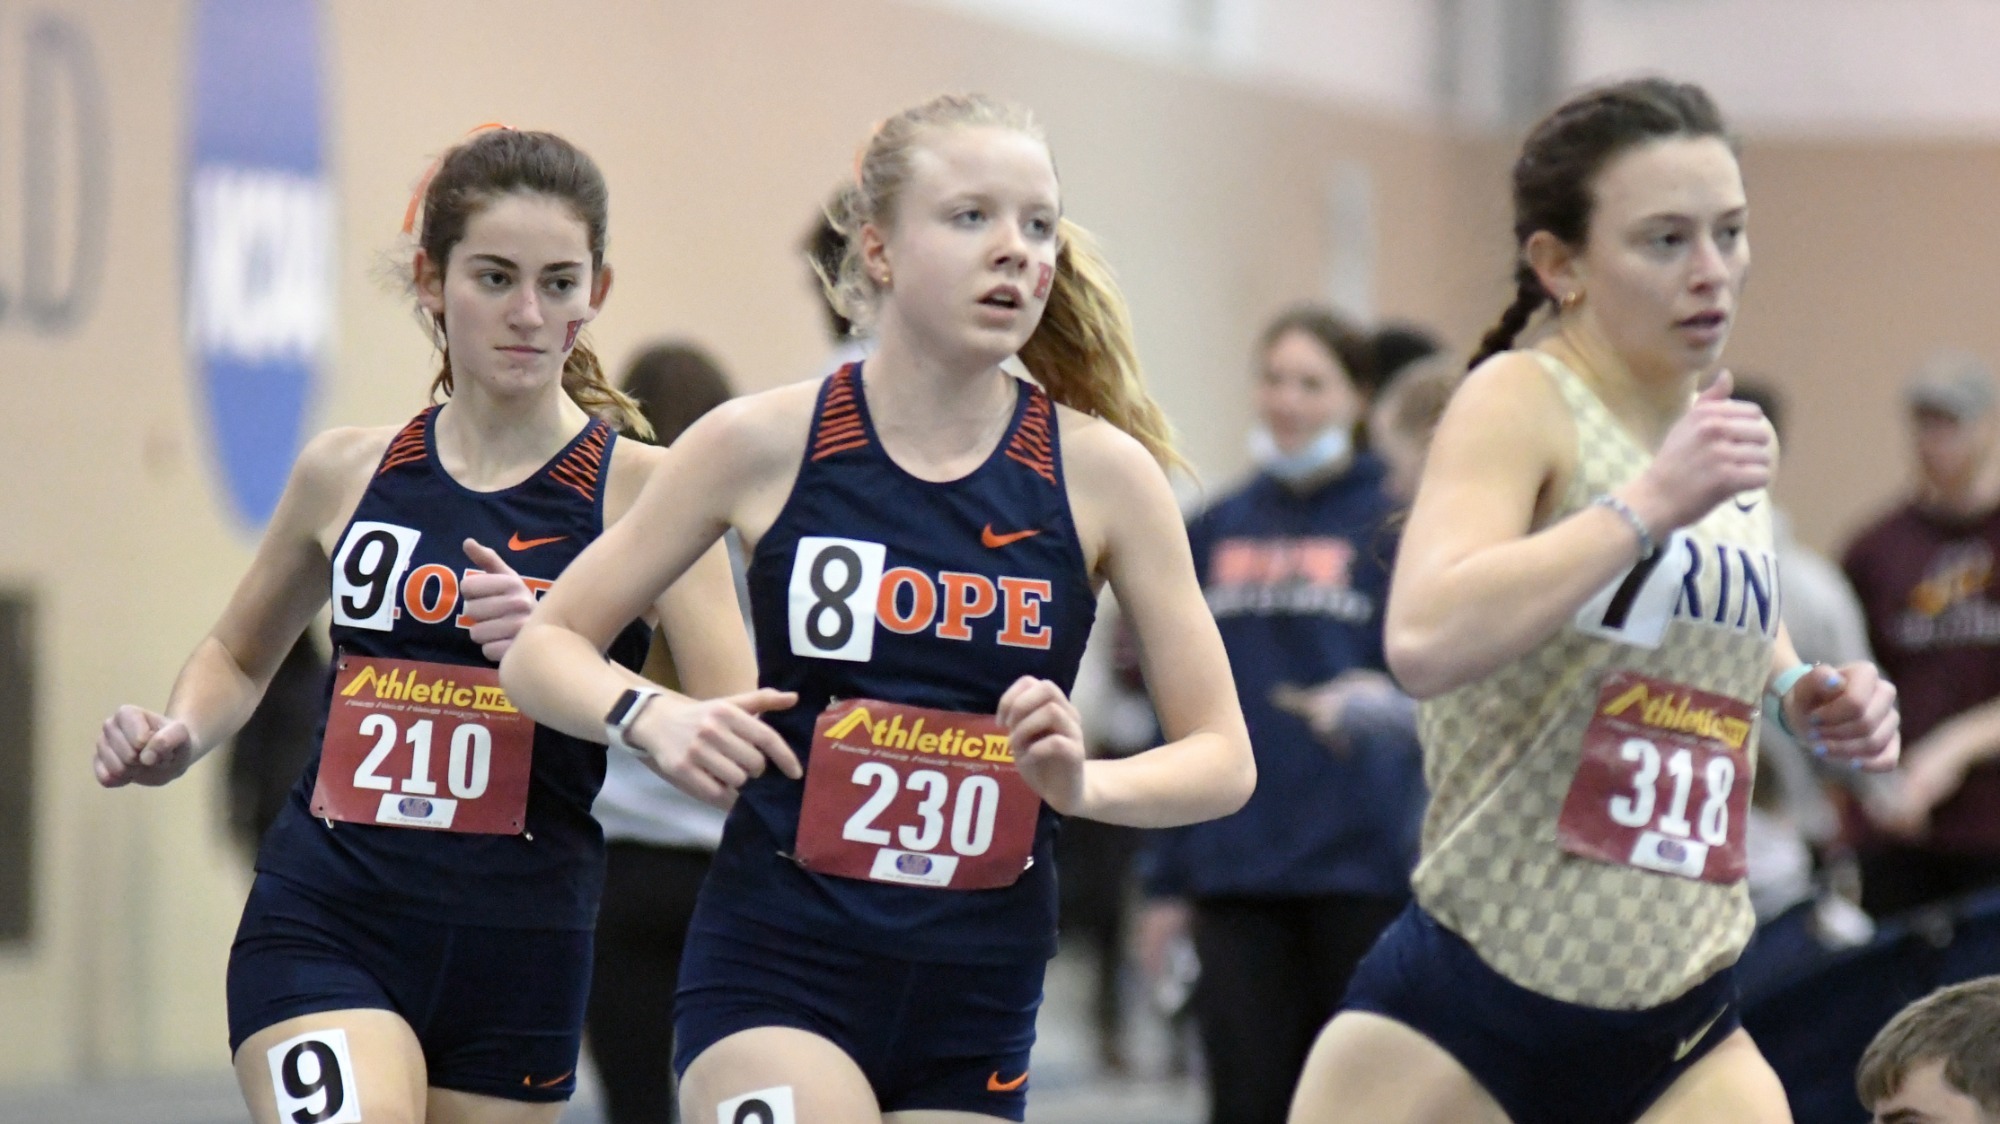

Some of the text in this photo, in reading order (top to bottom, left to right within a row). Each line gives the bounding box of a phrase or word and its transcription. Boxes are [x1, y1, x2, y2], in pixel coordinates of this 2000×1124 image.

[0, 10, 109, 335] D
[341, 530, 399, 620] 9
[805, 545, 863, 652] 8
[875, 566, 1052, 650] OPE
[1673, 536, 1782, 639] RIN
[353, 713, 492, 800] 210
[1607, 737, 1736, 847] 318
[842, 761, 1000, 857] 230
[281, 1040, 345, 1124] 9
